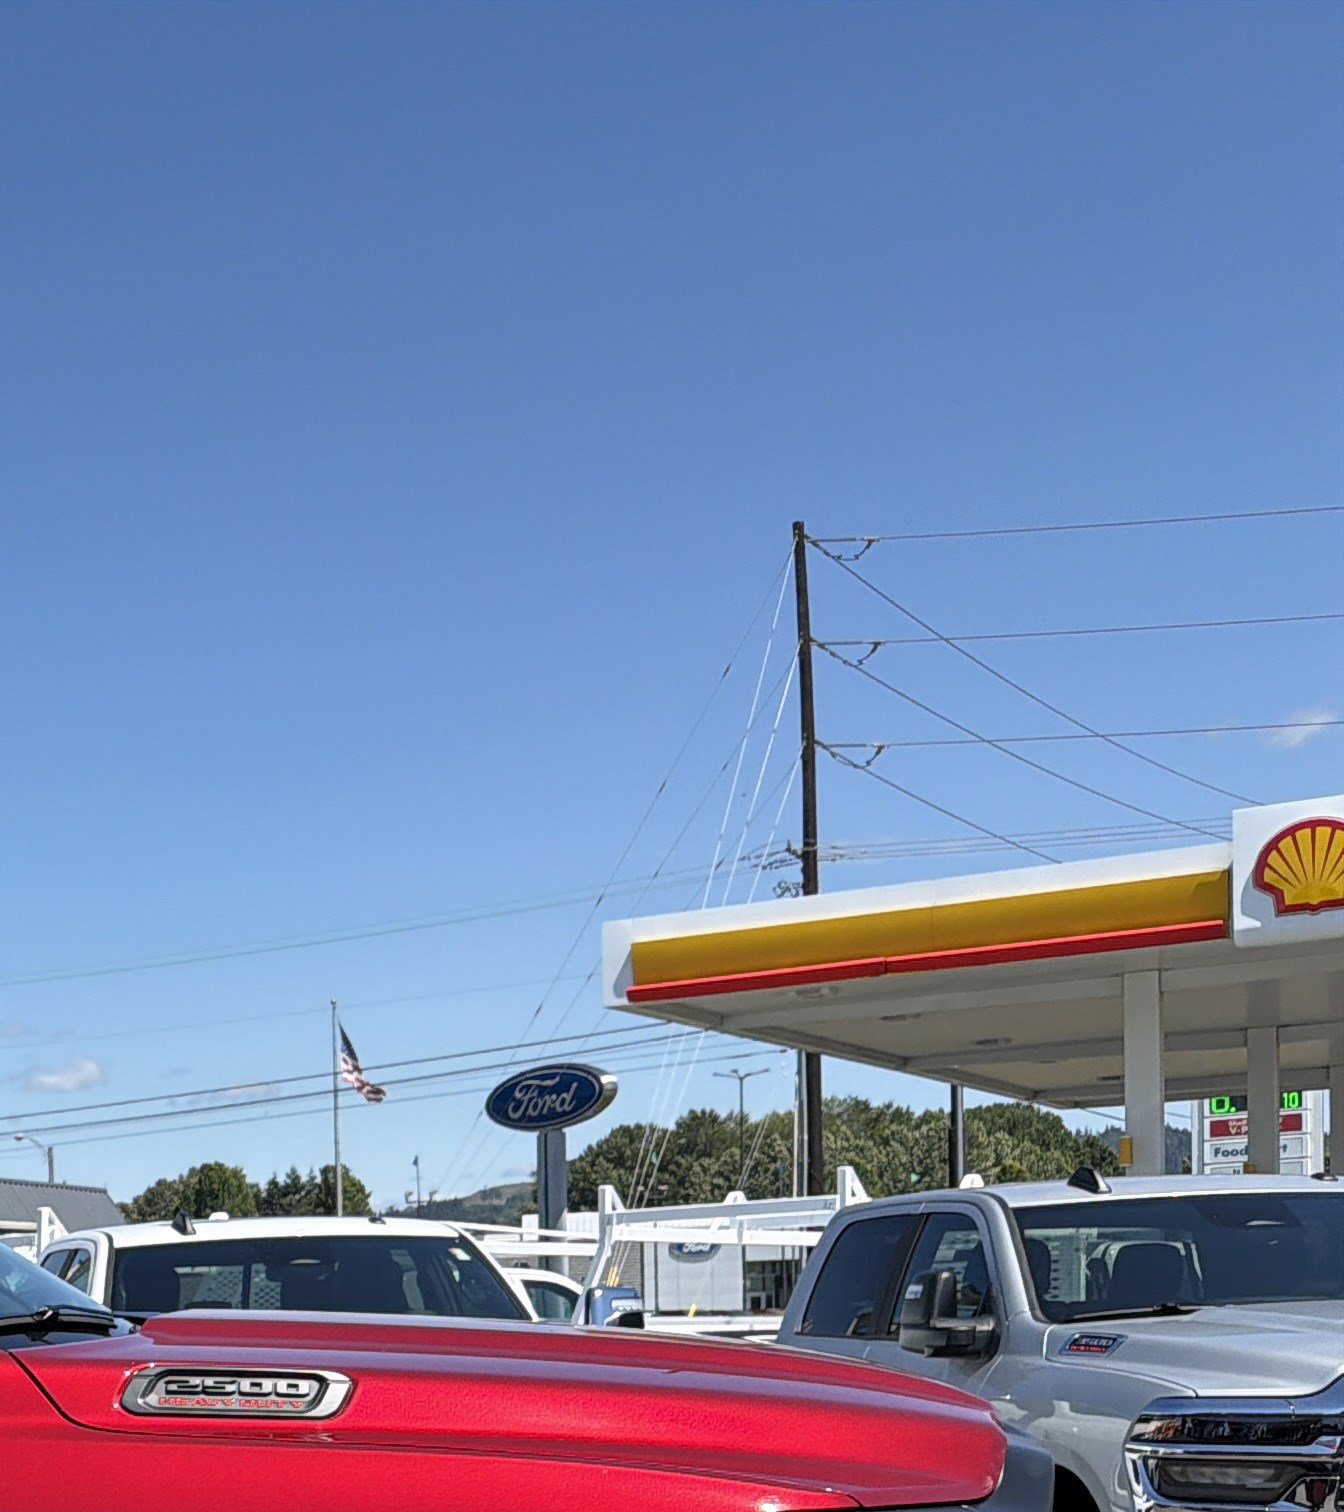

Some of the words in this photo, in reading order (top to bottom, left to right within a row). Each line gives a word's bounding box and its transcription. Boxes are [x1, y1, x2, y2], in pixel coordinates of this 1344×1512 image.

[507, 1074, 578, 1120] Ford
[163, 1378, 310, 1398] 2500
[158, 1396, 236, 1408] HEAVY
